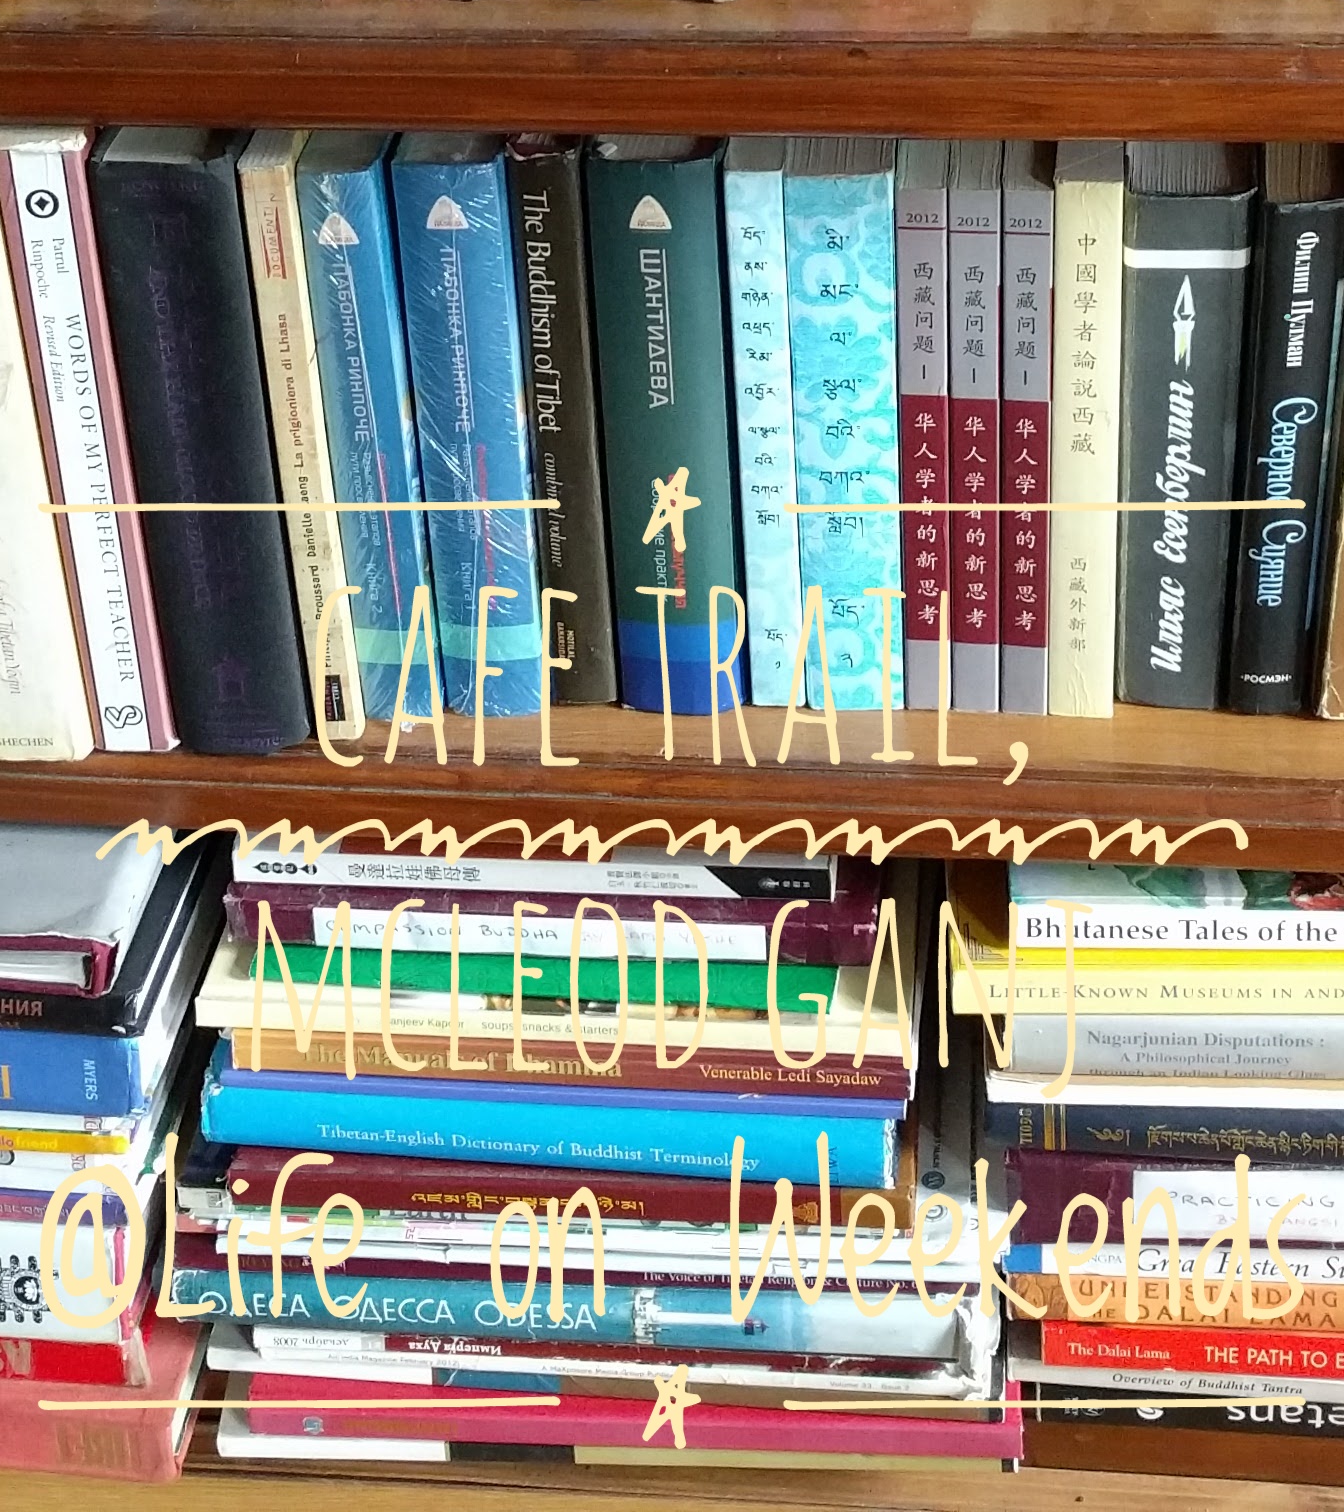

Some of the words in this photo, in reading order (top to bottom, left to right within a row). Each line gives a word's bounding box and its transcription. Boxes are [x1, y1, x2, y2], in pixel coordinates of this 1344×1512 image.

[905, 212, 939, 225] 2012
[639, 249, 673, 410] ШАНТИДЕВА
[1025, 917, 1169, 945] Bhutanese
[1177, 919, 1249, 944] Tales
[1258, 918, 1289, 944] of
[1295, 920, 1340, 944] the
[83, 1058, 98, 1101] MYERS
[317, 1124, 446, 1147] Tibetan-English
[451, 1133, 538, 1156] Dictionary
[544, 1140, 566, 1156] of
[570, 1141, 643, 1161] Buddhist
[1205, 1346, 1239, 1364] THE
[1247, 1348, 1294, 1366] PATH
[1301, 1351, 1328, 1368] TO
